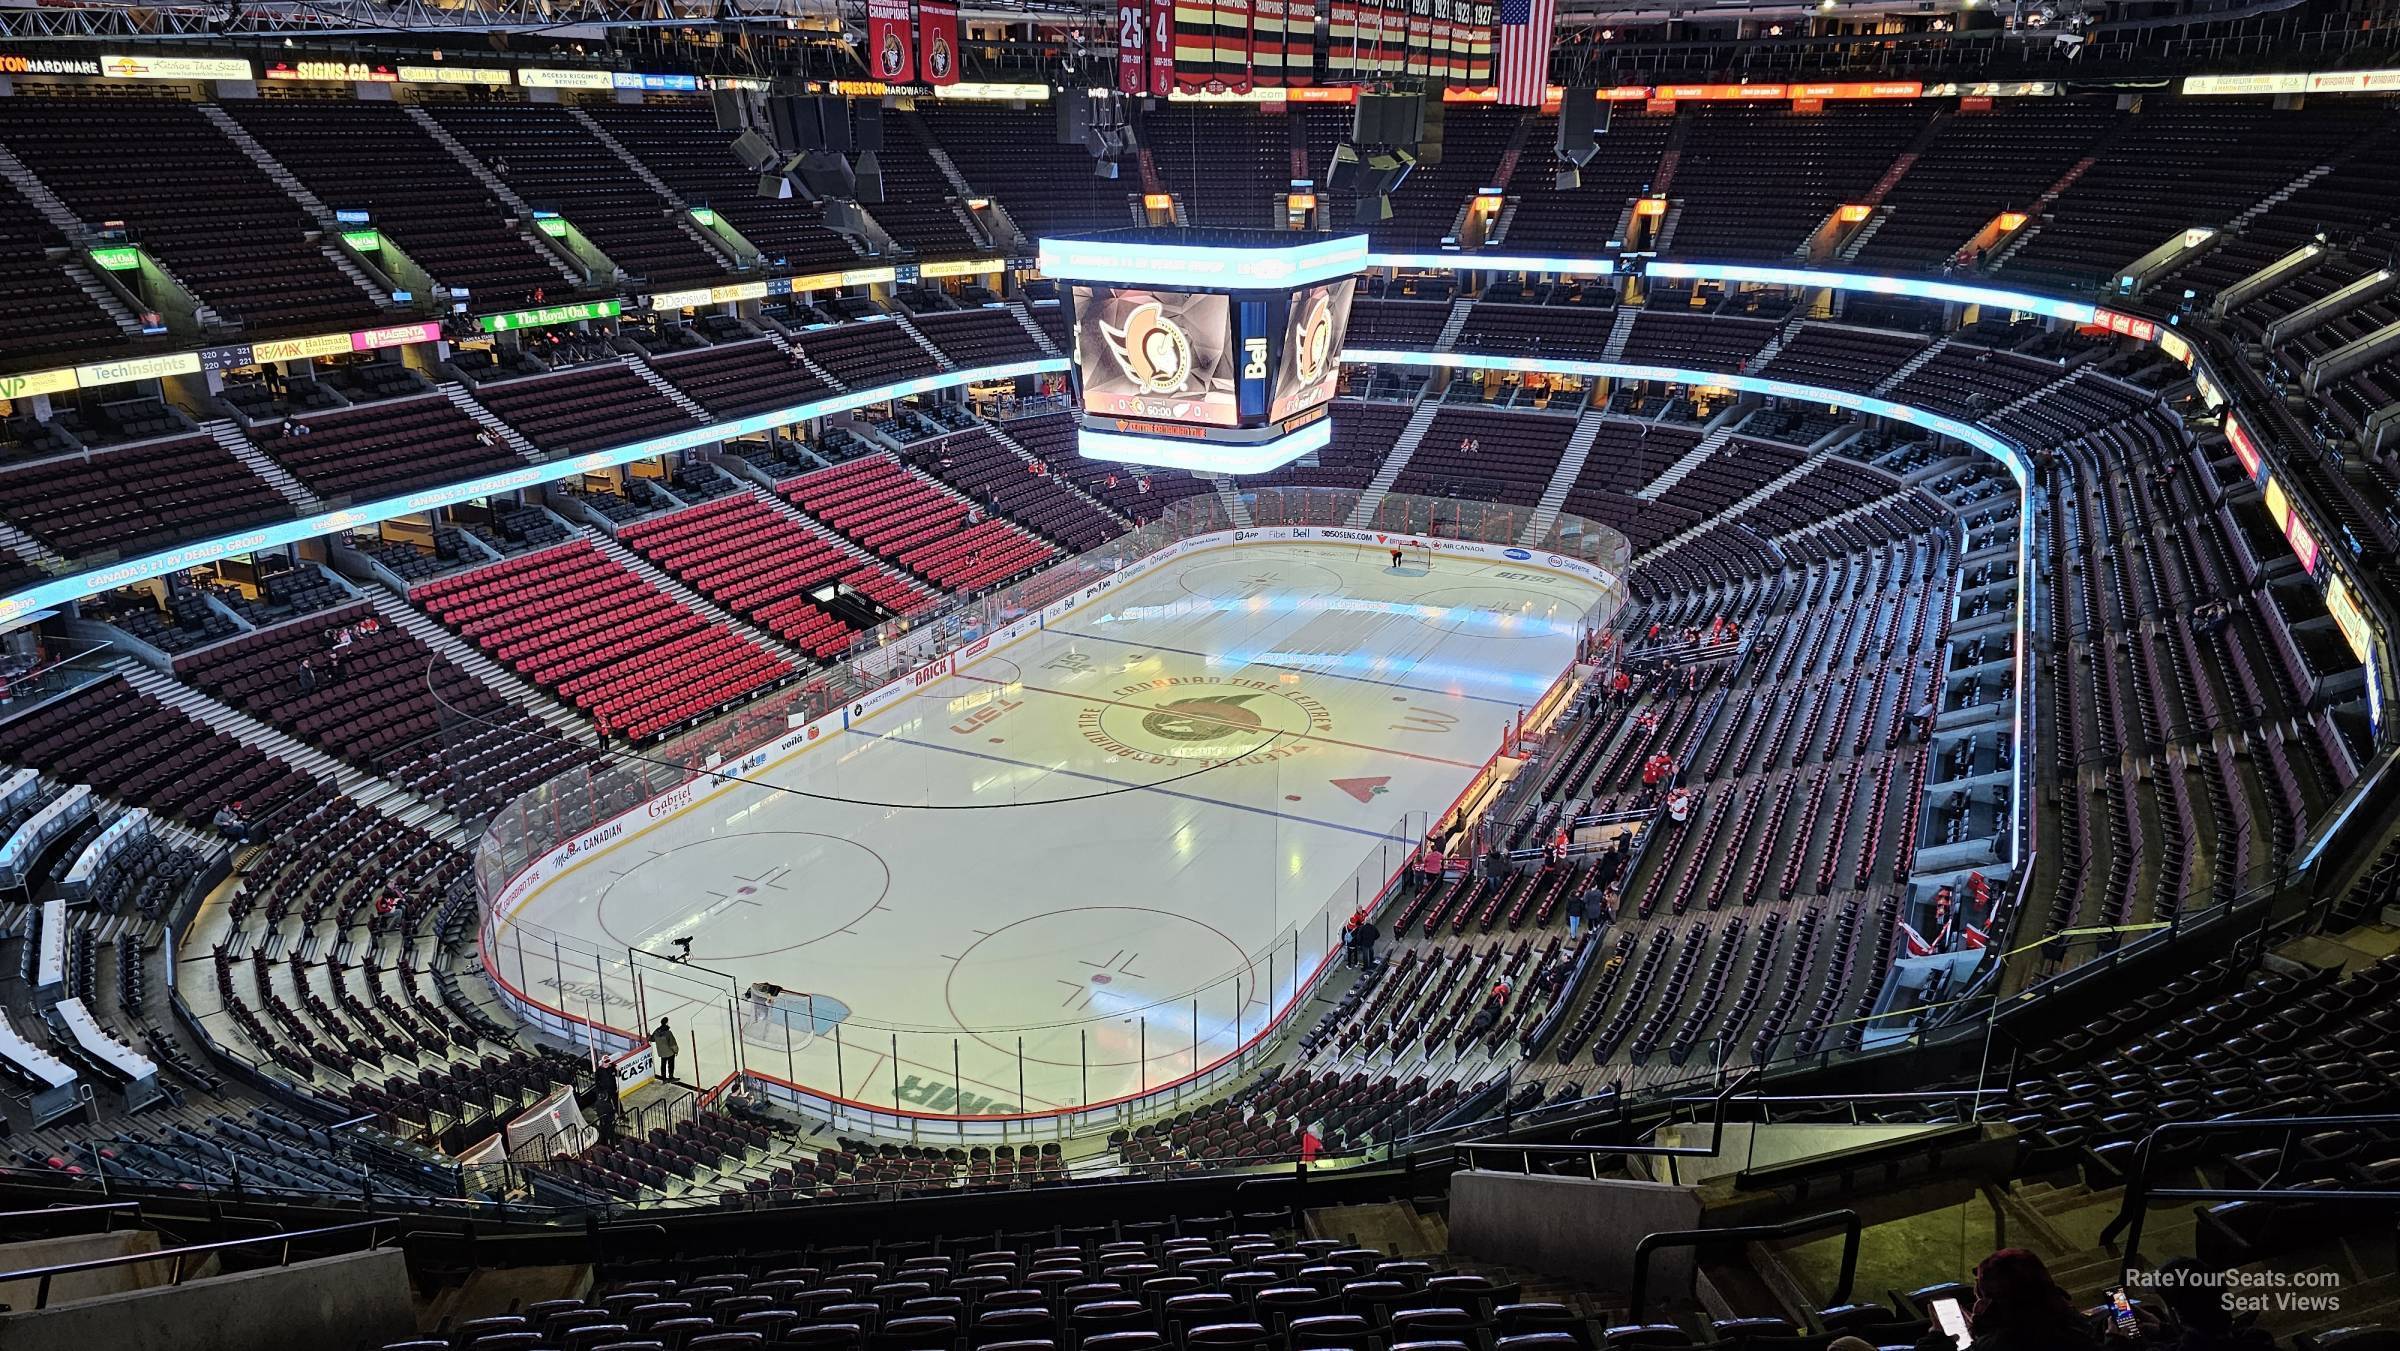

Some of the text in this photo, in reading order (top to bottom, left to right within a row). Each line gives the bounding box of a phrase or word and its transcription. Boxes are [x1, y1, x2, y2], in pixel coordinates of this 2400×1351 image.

[869, 5, 909, 20] CHAMPIONS
[1289, 2, 1315, 17] CHAMPIONS
[1455, 1, 1470, 24] 1923
[1475, 5, 1492, 25] 1927
[1120, 7, 1143, 48] 25
[1156, 12, 1167, 52] 4
[297, 62, 369, 80] SIGNS.CA
[666, 293, 707, 307] Decisive
[516, 305, 590, 325] The Royal Oak
[305, 335, 349, 348] Hallmark
[202, 347, 251, 359] 320 321
[256, 342, 303, 361] RE/MAX
[1245, 338, 1267, 379] Bell
[92, 357, 186, 380] TechInsights
[204, 357, 252, 370] 220 221
[1119, 399, 1125, 410] 0
[1147, 406, 1171, 416] 60:00
[1194, 406, 1201, 417] 0
[1293, 528, 1310, 539] Bell
[1321, 529, 1372, 541] 5050SENS.COM
[1455, 544, 1485, 553] CANADA
[86, 534, 266, 588] CANADA'S #1 RV DEALER GROUP
[1564, 559, 1591, 574] Supreme
[1064, 597, 1075, 611] Bell
[915, 659, 947, 687] BRICK
[864, 694, 882, 709] PLANET
[1113, 676, 1332, 724] CANADIAN TIRE CENTRE
[781, 733, 803, 751] voilà
[648, 784, 692, 818] Gabriel
[662, 797, 693, 816] PIZZA
[584, 823, 622, 850] CANADIAN
[503, 870, 540, 911] CANADIAN TIRE
